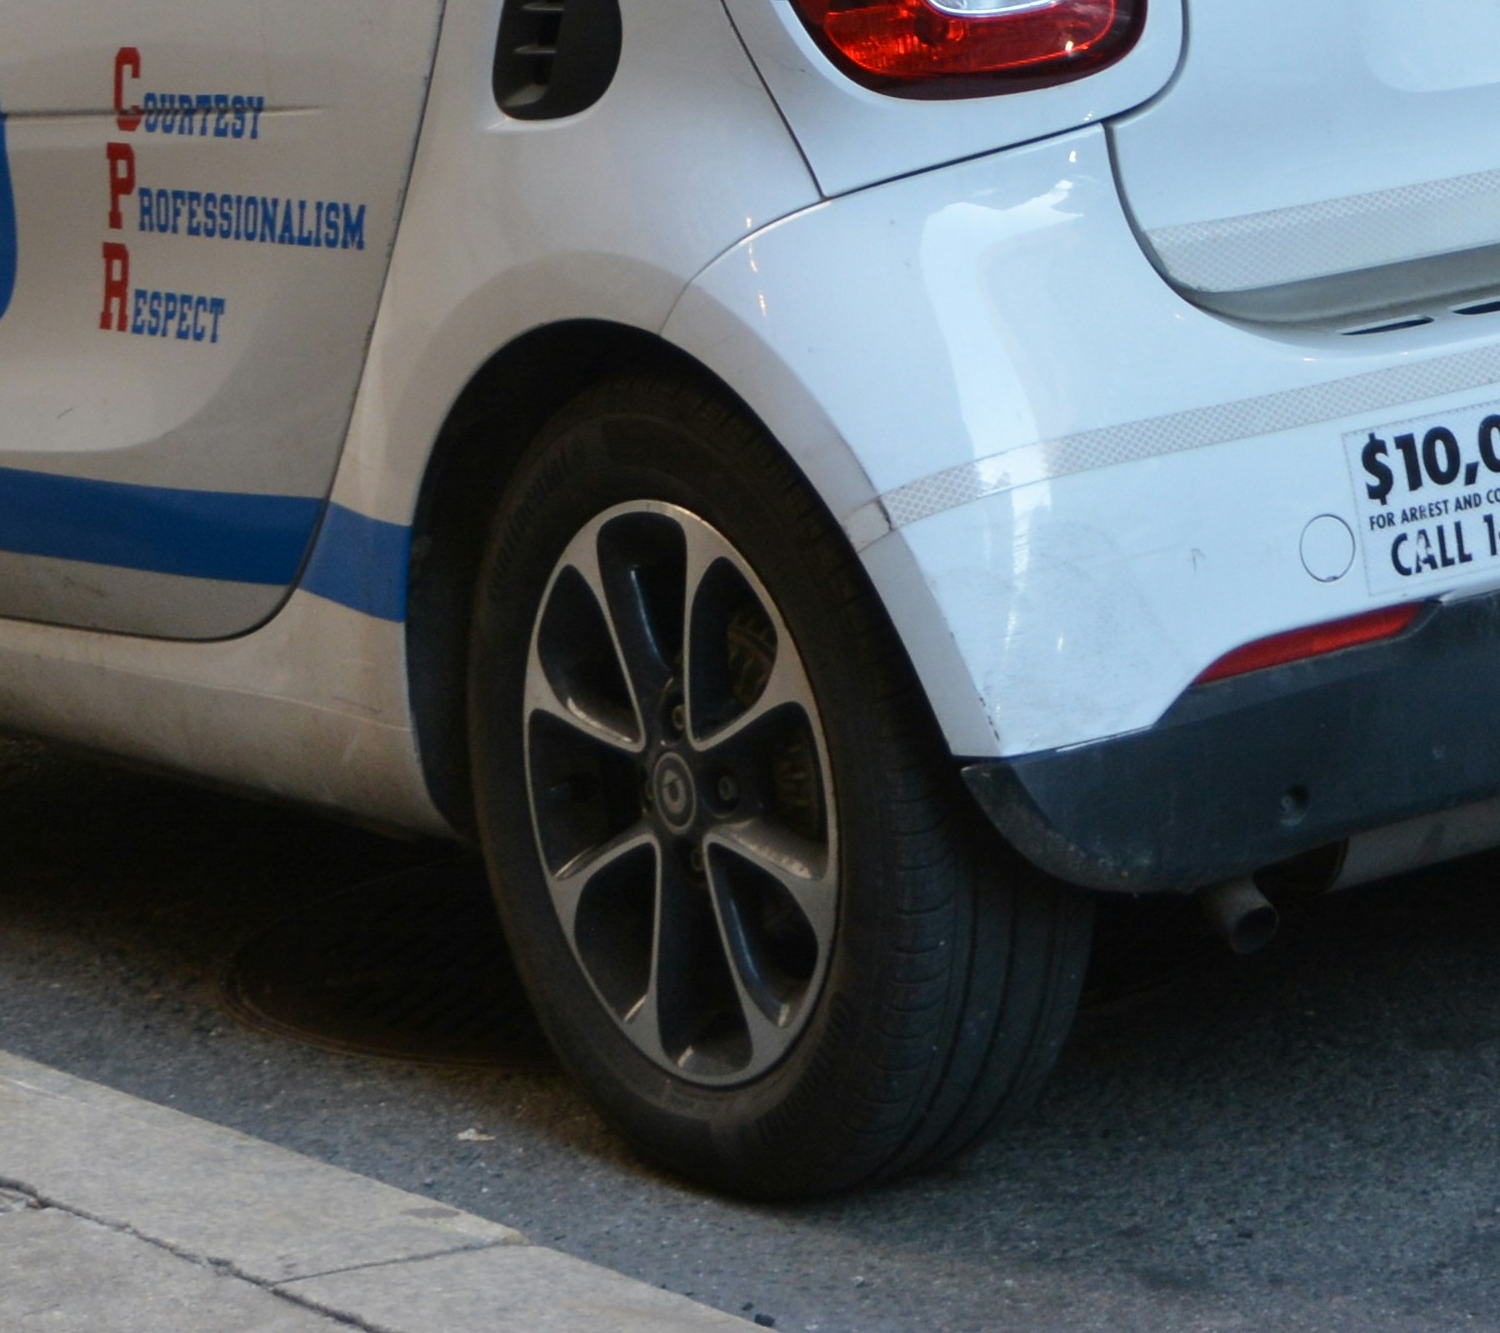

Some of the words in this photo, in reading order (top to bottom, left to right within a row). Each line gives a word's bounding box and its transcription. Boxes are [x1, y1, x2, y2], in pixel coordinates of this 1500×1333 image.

[114, 47, 264, 139] COURTESY
[106, 142, 366, 250] PROFESSIONALISM
[100, 242, 226, 343] RESPECT
[1369, 512, 1395, 531] FOR
[1401, 499, 1450, 521] ARREST
[1454, 493, 1482, 512] AND
[1391, 520, 1473, 576] CALL
